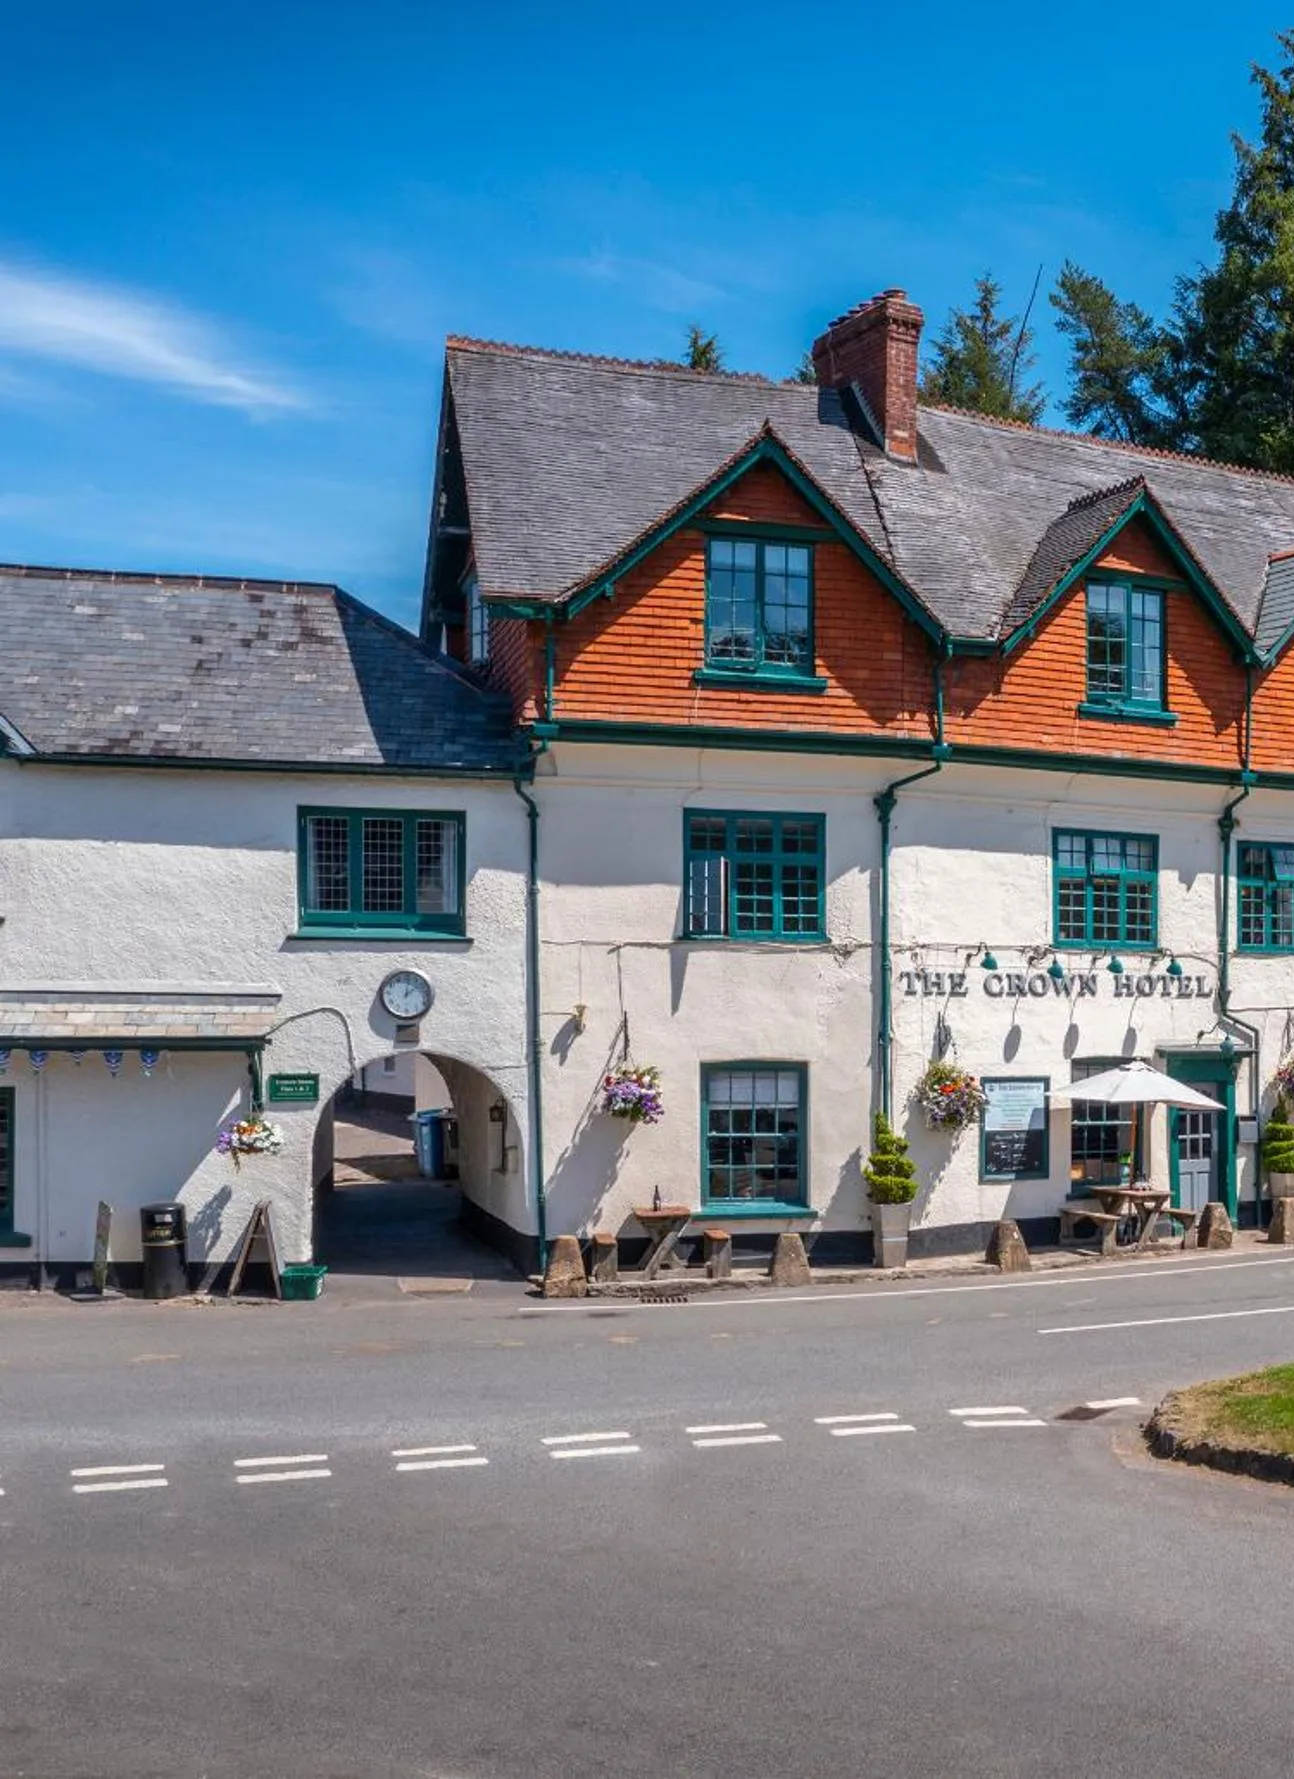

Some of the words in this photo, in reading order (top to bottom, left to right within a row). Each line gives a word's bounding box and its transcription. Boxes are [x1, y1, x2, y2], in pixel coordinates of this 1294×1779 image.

[900, 970, 969, 998] THE
[983, 972, 1098, 998] CROWN
[1113, 974, 1214, 999] HOTEL
